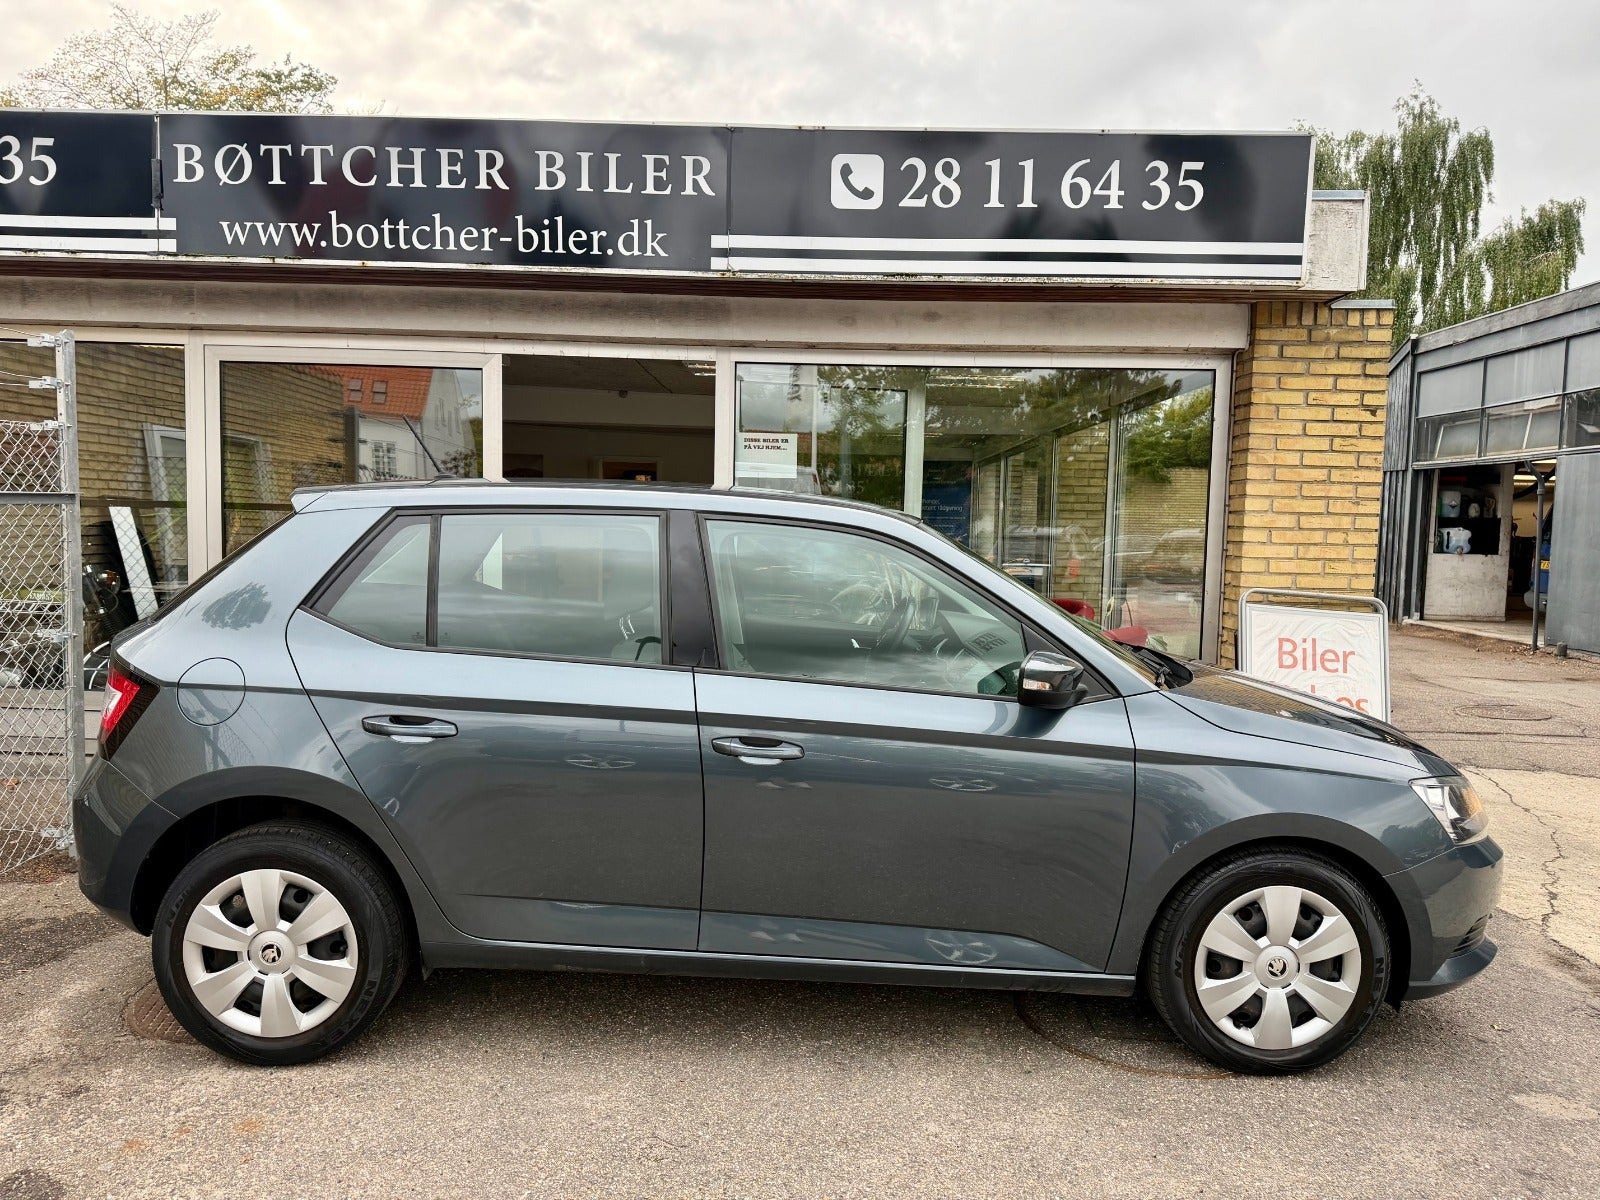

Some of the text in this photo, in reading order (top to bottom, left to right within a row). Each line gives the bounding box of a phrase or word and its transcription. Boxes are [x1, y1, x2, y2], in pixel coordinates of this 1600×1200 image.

[0, 135, 57, 186] 35
[172, 141, 717, 197] BØTTCHER BILER
[898, 157, 1206, 212] 28 11 64 35
[218, 210, 670, 258] www.bottcher-biler.dk
[1277, 637, 1355, 674] Biler
